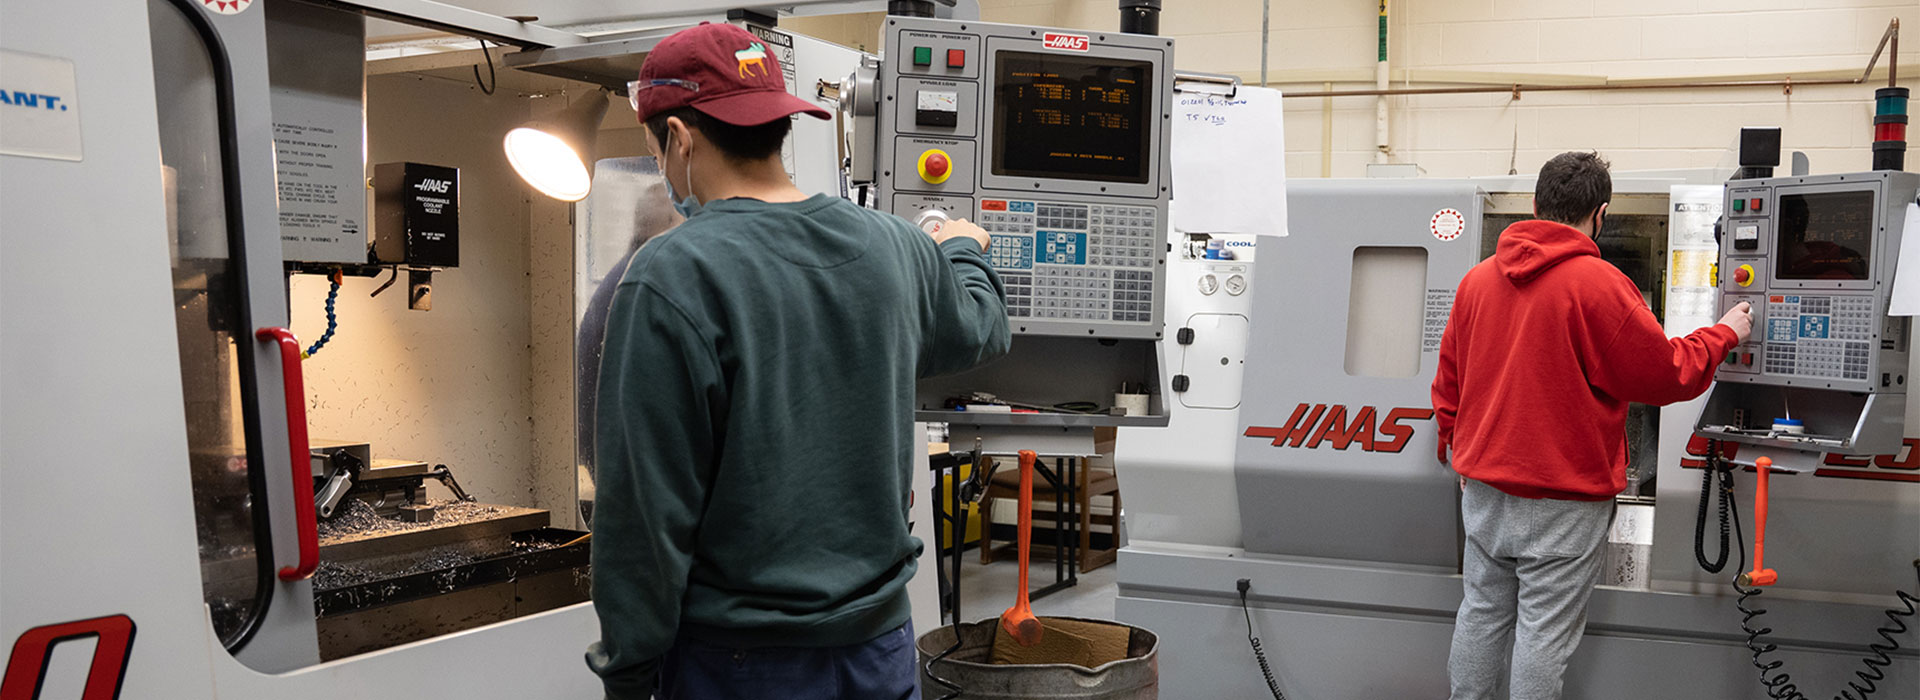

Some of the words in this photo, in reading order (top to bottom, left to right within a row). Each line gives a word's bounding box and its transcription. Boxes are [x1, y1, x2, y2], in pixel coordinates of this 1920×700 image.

[750, 26, 790, 46] WARNING
[1044, 34, 1089, 50] HAAS
[414, 178, 452, 193] HAAS
[416, 196, 450, 204] PROGRAMMABLE
[1244, 402, 1434, 453] HAAS
